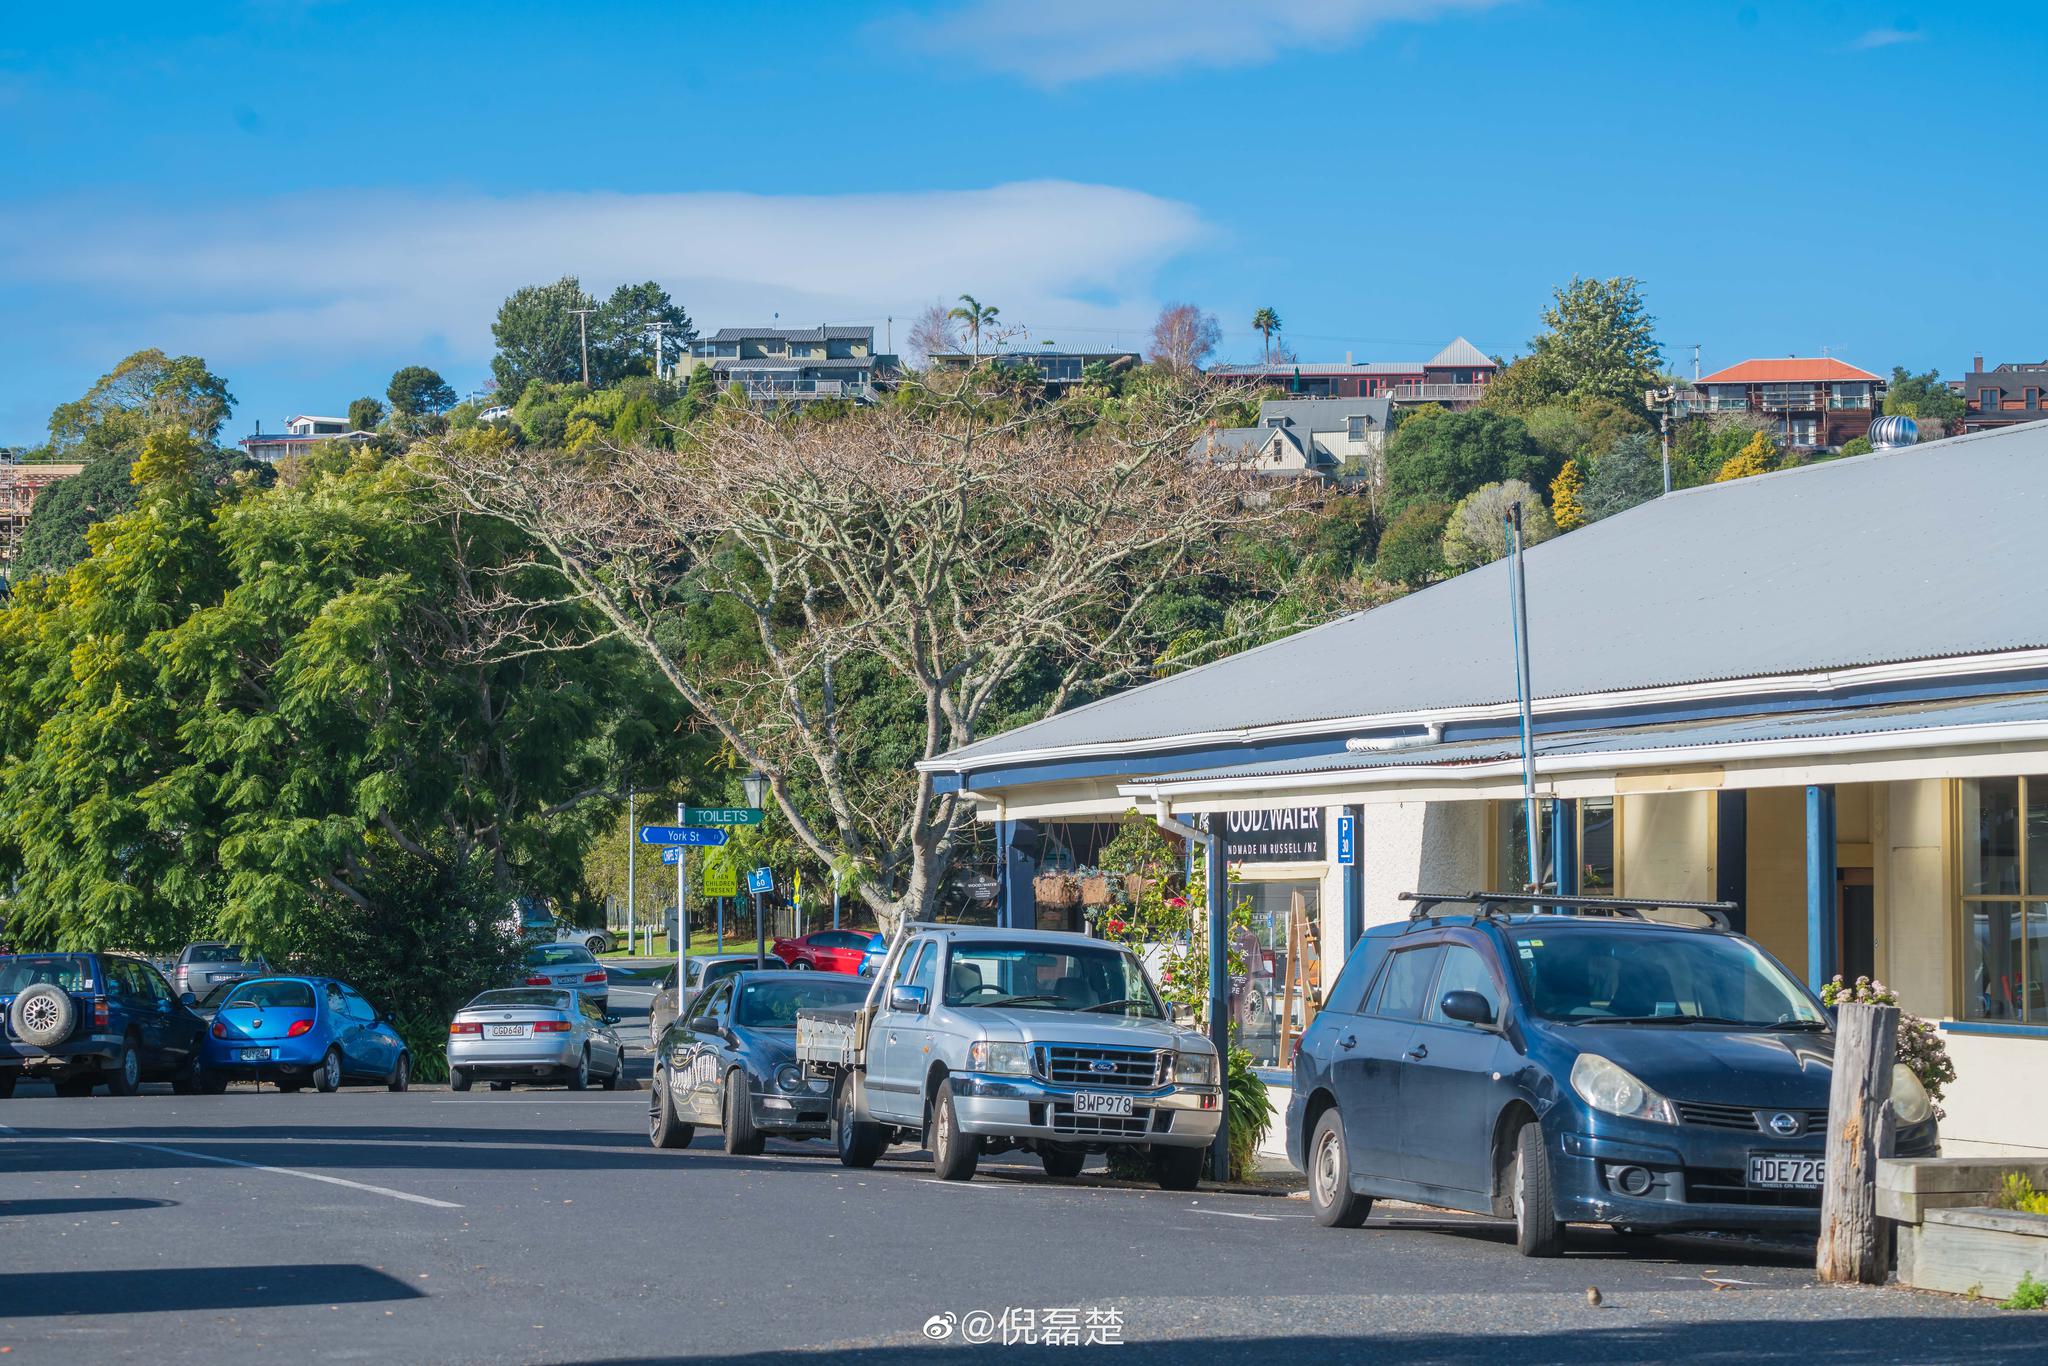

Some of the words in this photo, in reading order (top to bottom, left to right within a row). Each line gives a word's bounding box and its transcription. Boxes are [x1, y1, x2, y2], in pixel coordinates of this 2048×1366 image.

[696, 810, 748, 822] TOILETS
[1342, 819, 1349, 837] P
[668, 830, 687, 841] York
[690, 831, 700, 842] St
[1259, 843, 1267, 854] IN
[1270, 842, 1302, 854] RUSSELL
[1341, 839, 1349, 853] 30
[756, 870, 763, 879] P
[1077, 1095, 1131, 1113] BWP978
[1751, 1160, 1825, 1182] HDE726
